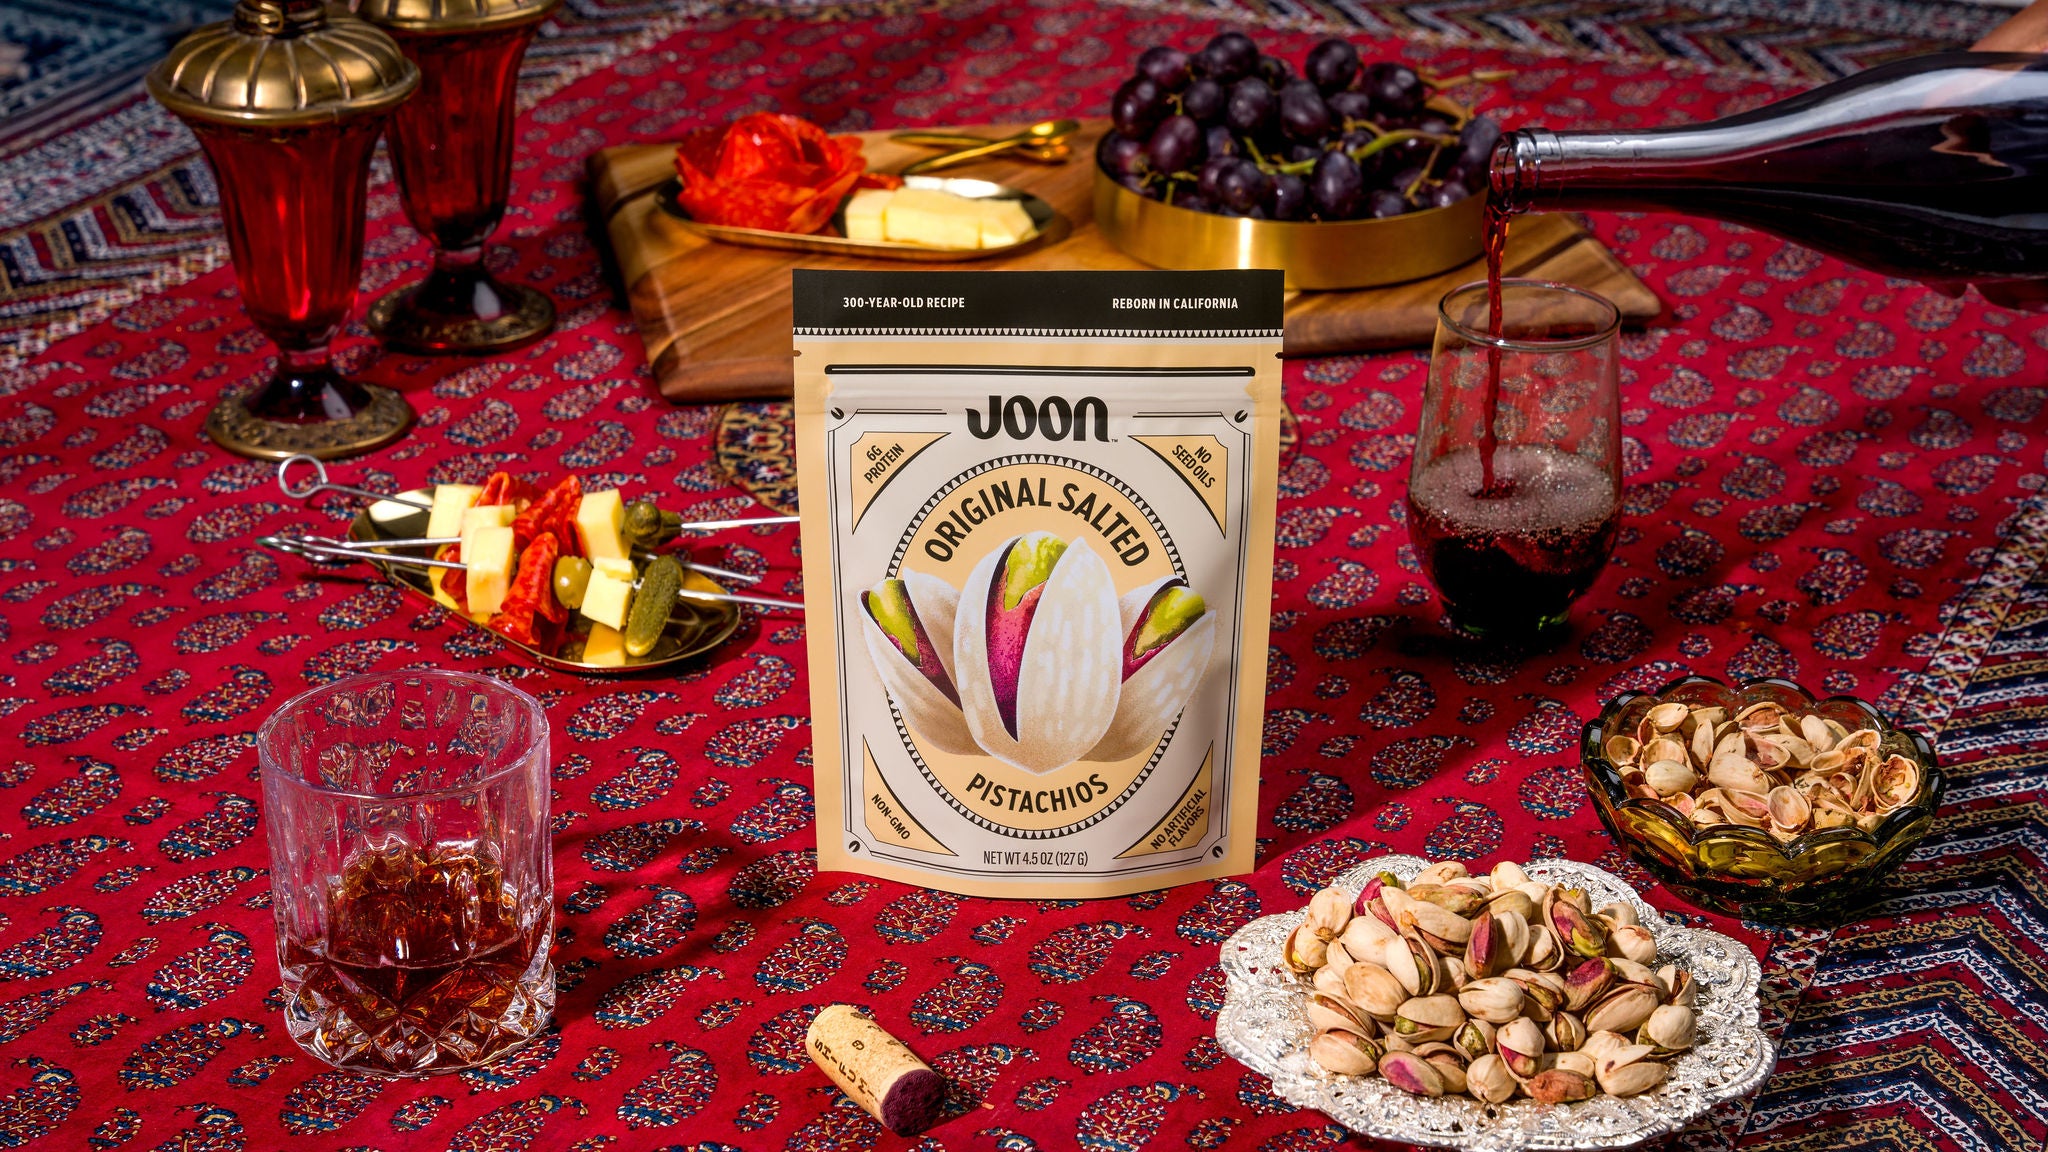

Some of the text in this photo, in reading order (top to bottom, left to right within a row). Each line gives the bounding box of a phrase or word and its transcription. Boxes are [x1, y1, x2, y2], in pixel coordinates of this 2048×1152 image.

[842, 296, 965, 309] 300-YEAR-OLD RECIPE
[1112, 297, 1239, 310] REBORN IN CALIFORNIA
[965, 394, 1110, 443] JOON
[863, 442, 905, 484] PROTEIN
[866, 444, 883, 462] 6G
[1171, 444, 1216, 489] SEED OILS
[1194, 445, 1212, 464] NO
[924, 477, 1150, 567] ORIGINAL SALTED
[965, 772, 1110, 814] PISTACHIOS
[870, 793, 911, 841] NON-GMO
[1150, 788, 1208, 850] NO ARTIFICIAL
[1167, 805, 1206, 848] FLAVORS
[983, 850, 1089, 868] NET WT 4.5 OZ (127 G)
